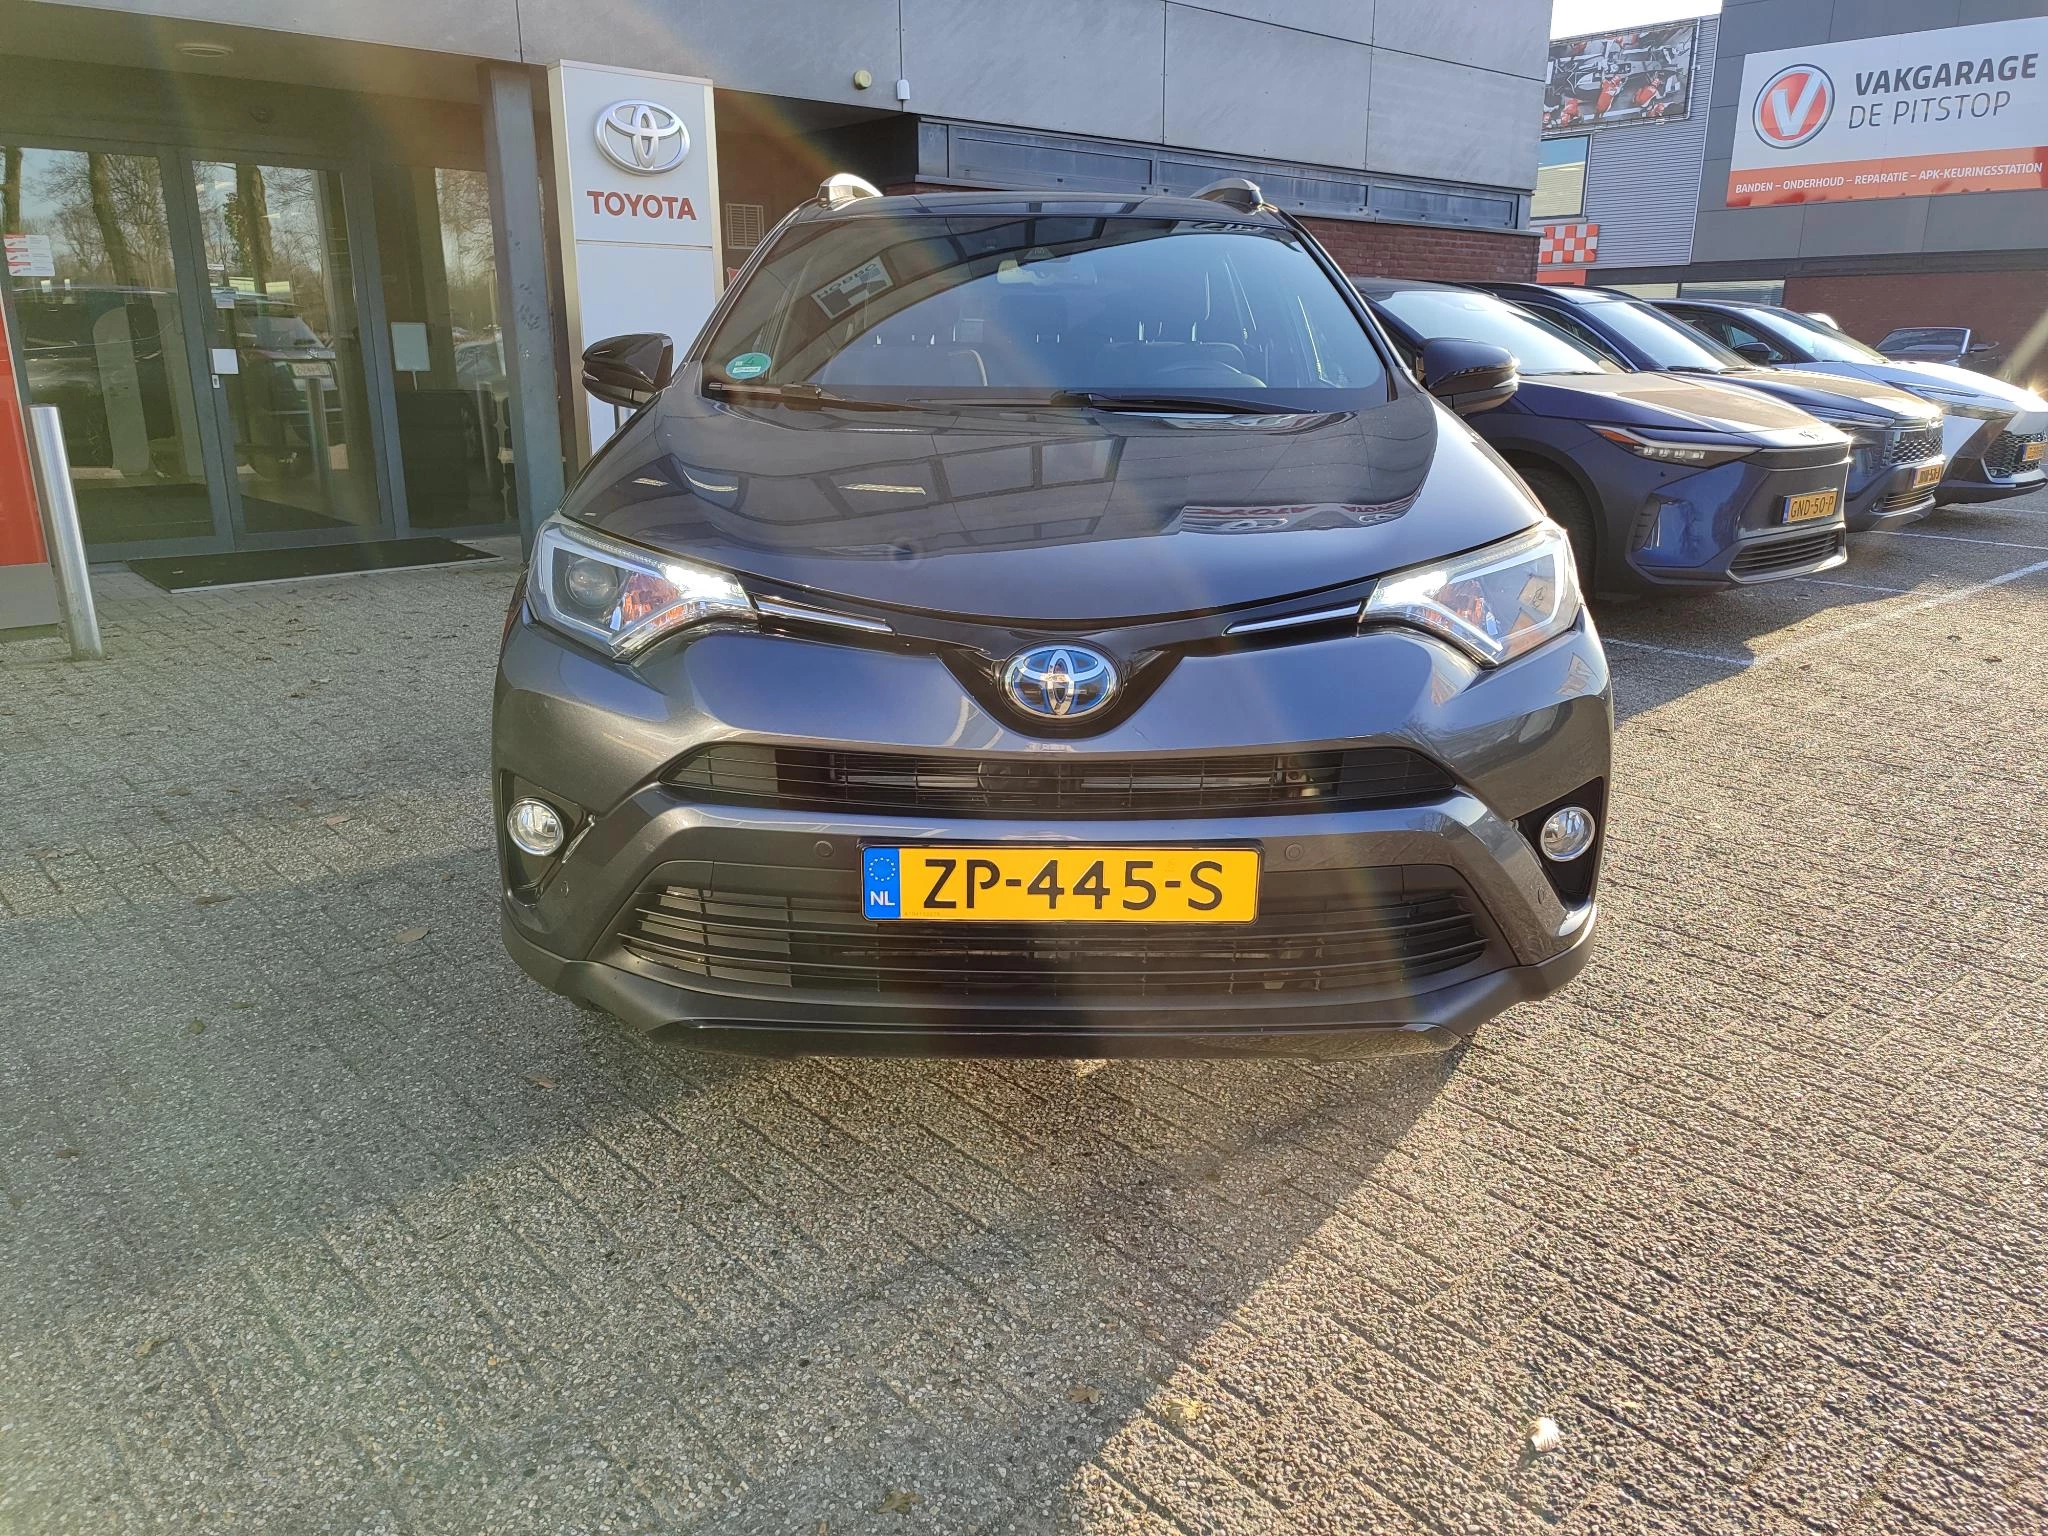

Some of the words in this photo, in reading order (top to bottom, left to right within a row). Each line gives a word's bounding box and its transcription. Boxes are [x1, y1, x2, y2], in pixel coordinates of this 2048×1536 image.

[1855, 53, 2039, 96] VAKGARAGE
[1848, 103, 1883, 129] DE
[1893, 90, 2011, 125] PITSTOP
[1735, 181, 1773, 194] BANDEN
[1783, 176, 1844, 190] ONDERHOUD
[1854, 171, 1908, 185] REPARATIE
[1918, 162, 2043, 181] APK-KEURINGSSTATION
[587, 190, 697, 221] TOYOTA
[1790, 495, 1835, 518] GND-50-P
[870, 890, 896, 906] NL
[923, 858, 1223, 911] ZP-445-S
